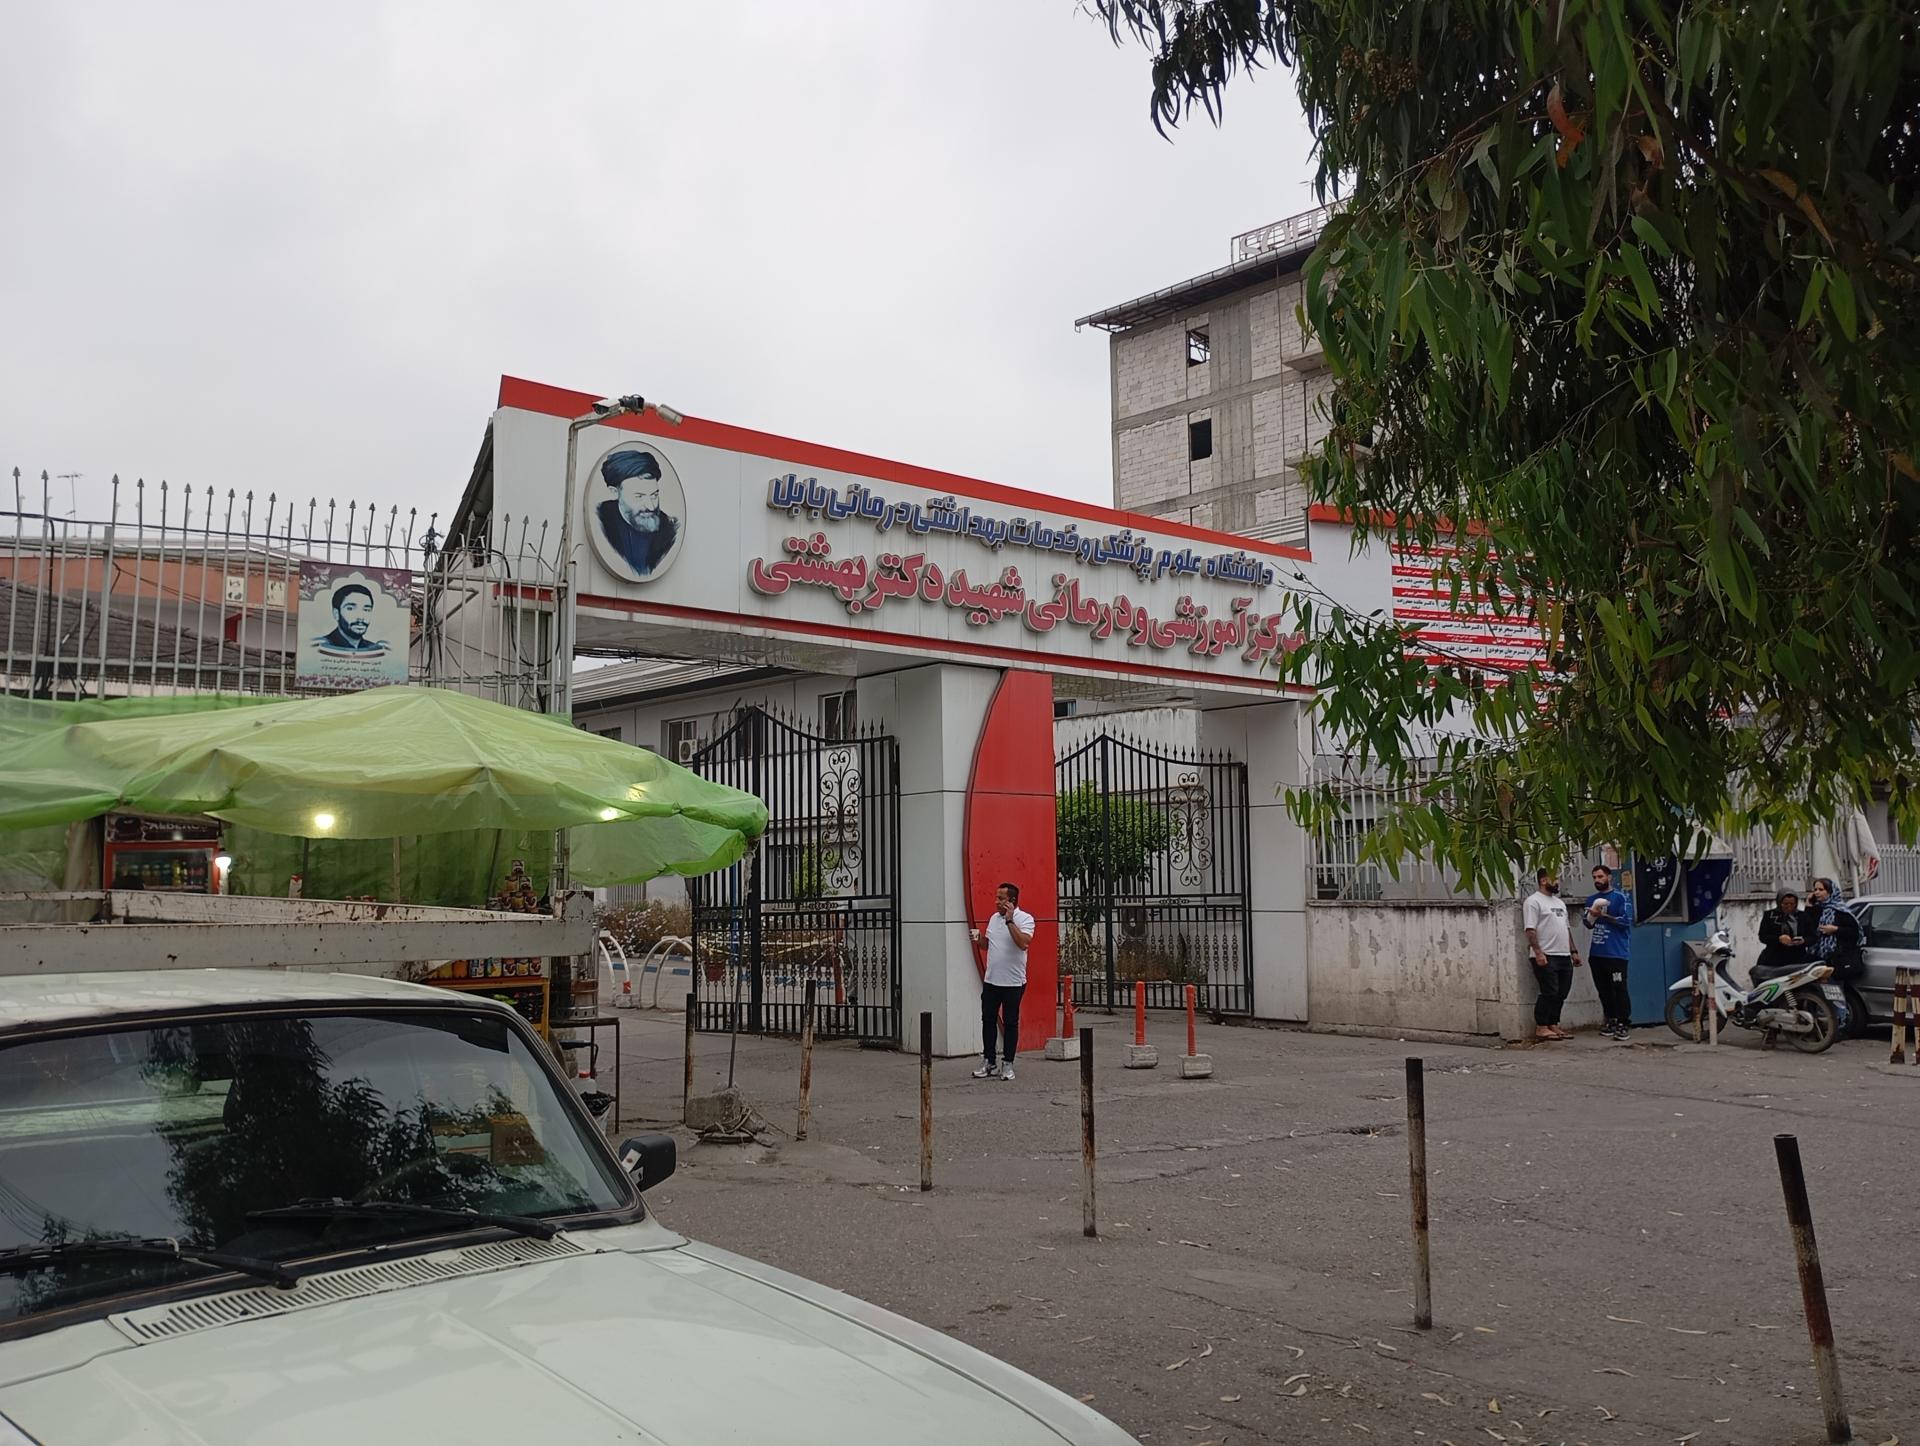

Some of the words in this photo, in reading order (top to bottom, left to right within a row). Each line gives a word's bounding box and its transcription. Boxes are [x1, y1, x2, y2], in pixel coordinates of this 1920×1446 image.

[767, 474, 828, 518] بابل
[824, 483, 912, 532] درمانی
[909, 496, 1006, 550] بهداشتی
[1007, 517, 1080, 554] خدمات
[748, 531, 868, 615] بهشتی
[1077, 537, 1091, 562] و
[1092, 530, 1153, 581] پزشکی
[1154, 548, 1202, 581] علوم
[1202, 551, 1274, 588] دانشگاه
[863, 552, 944, 609] دکتر
[945, 565, 1025, 626] شهید
[1024, 573, 1132, 640] درمانی
[1130, 606, 1150, 647] و
[1152, 595, 1253, 657] آموزشی
